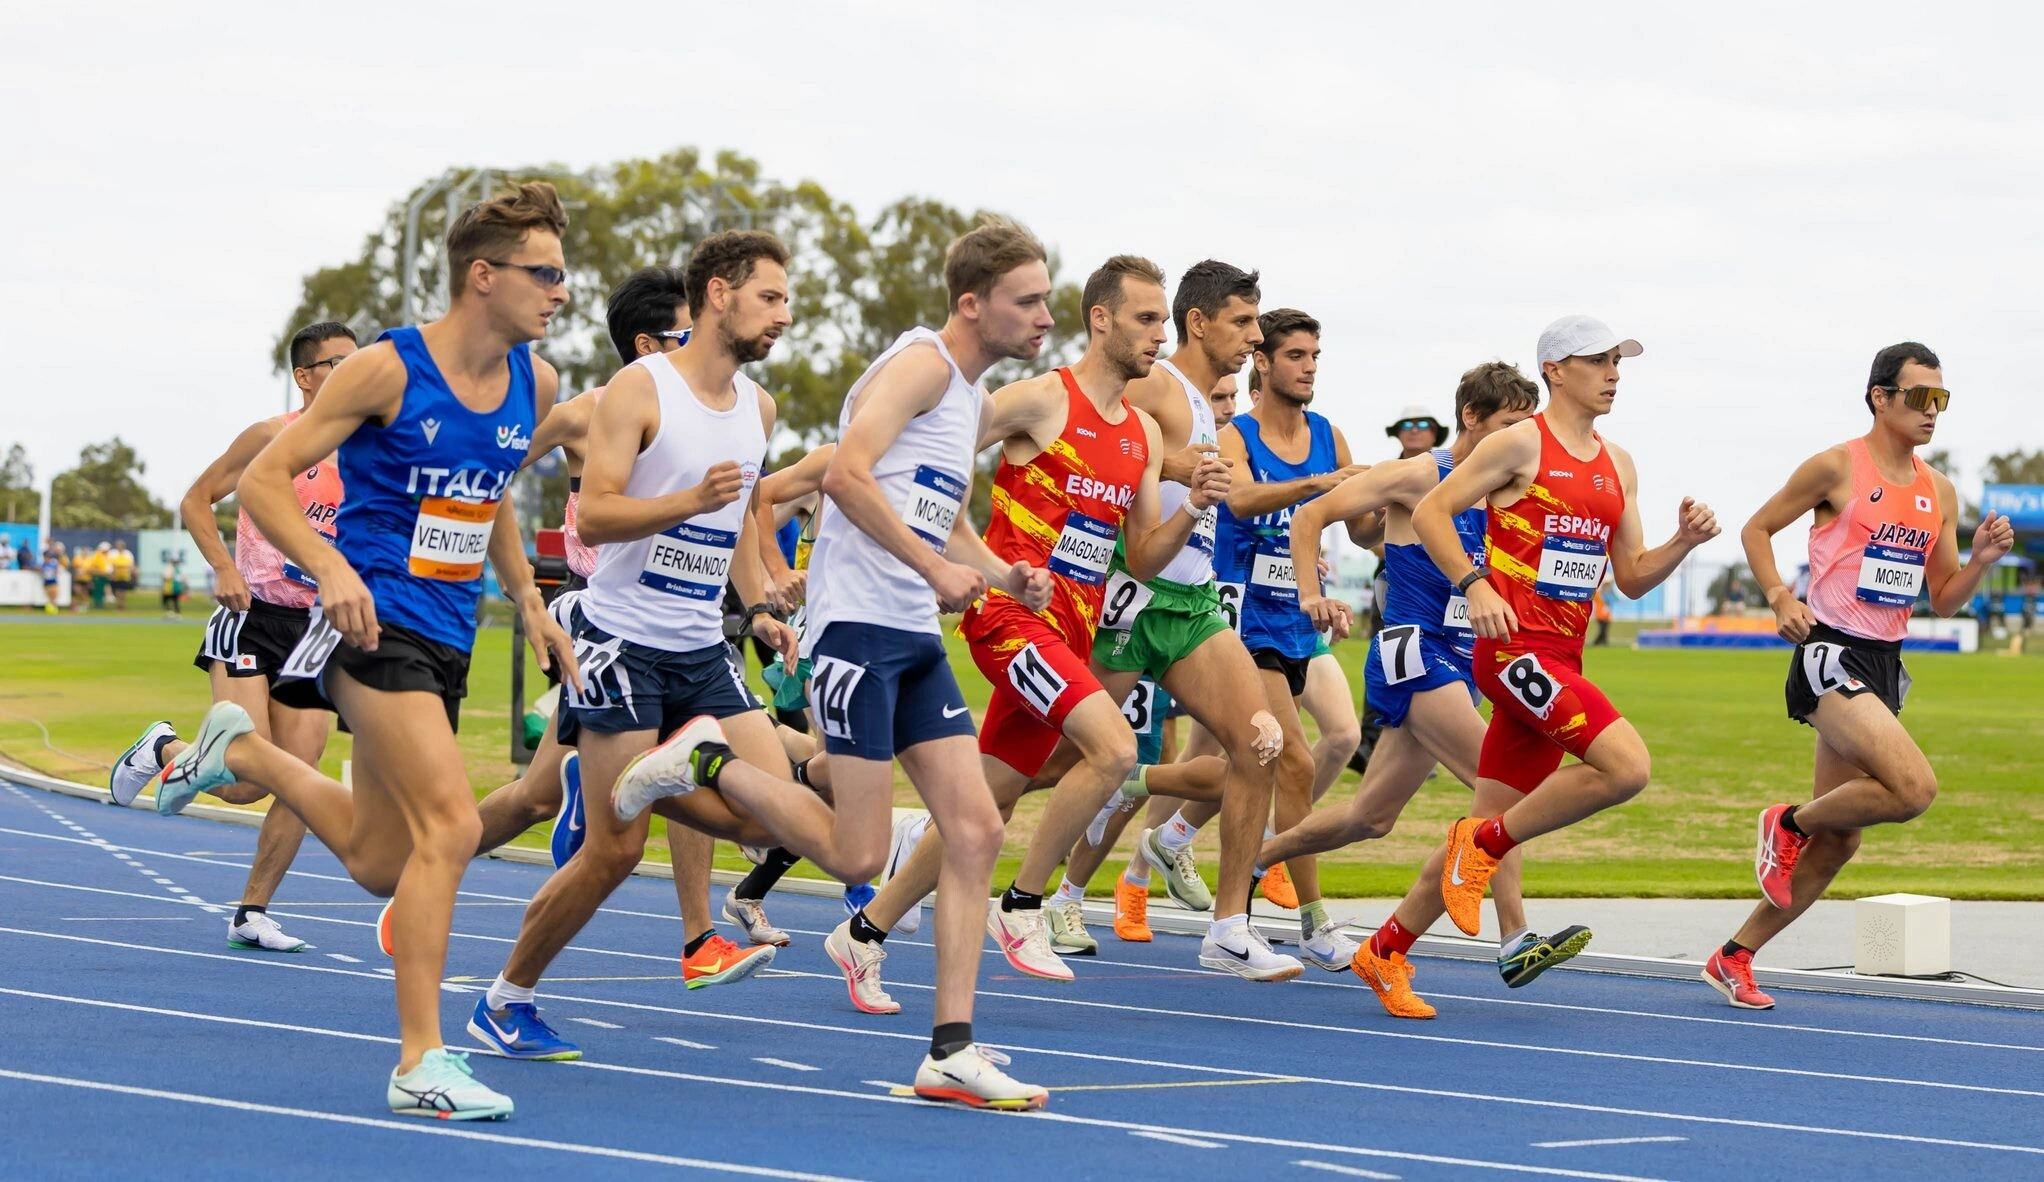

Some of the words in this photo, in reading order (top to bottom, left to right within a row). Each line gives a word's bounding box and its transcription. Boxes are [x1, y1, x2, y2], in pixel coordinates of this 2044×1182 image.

[1544, 514, 1610, 542] ESPAÑA
[1870, 522, 1930, 548] JAPAN
[653, 545, 727, 577] FERNANDO
[1554, 560, 1597, 580] PARRAS
[666, 582, 693, 594] Brisbane
[1559, 589, 1577, 598] Brisbane
[1875, 567, 1913, 588] MORITA
[1103, 581, 1137, 626] 9
[1878, 595, 1897, 604] Brisbane
[209, 608, 240, 659] 10
[1383, 627, 1415, 680] 7
[1813, 644, 1838, 689] 2
[1013, 648, 1061, 707] 11
[1508, 657, 1553, 709] 8
[813, 662, 857, 735] 14
